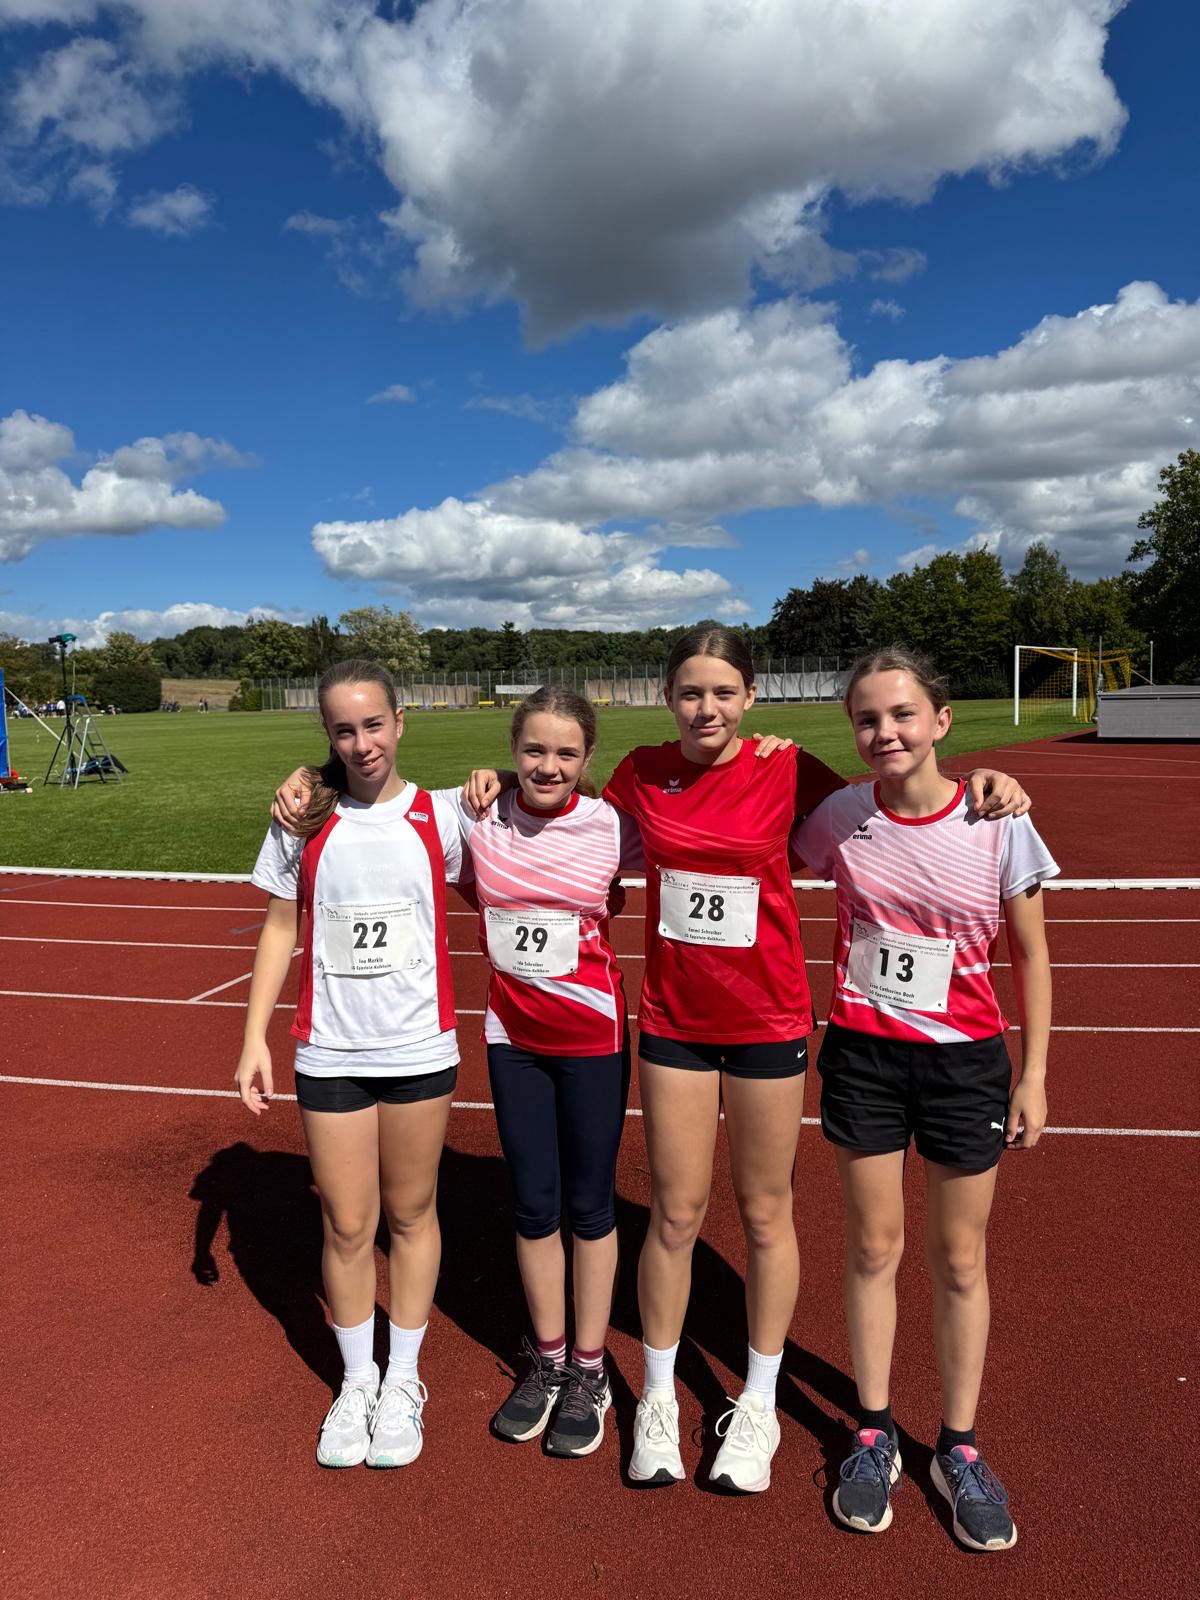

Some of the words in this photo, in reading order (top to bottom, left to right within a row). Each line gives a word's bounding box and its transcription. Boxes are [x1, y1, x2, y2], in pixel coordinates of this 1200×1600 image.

[688, 892, 724, 922] 28
[353, 921, 387, 949] 22
[515, 925, 548, 953] 29
[879, 947, 914, 983] 13
